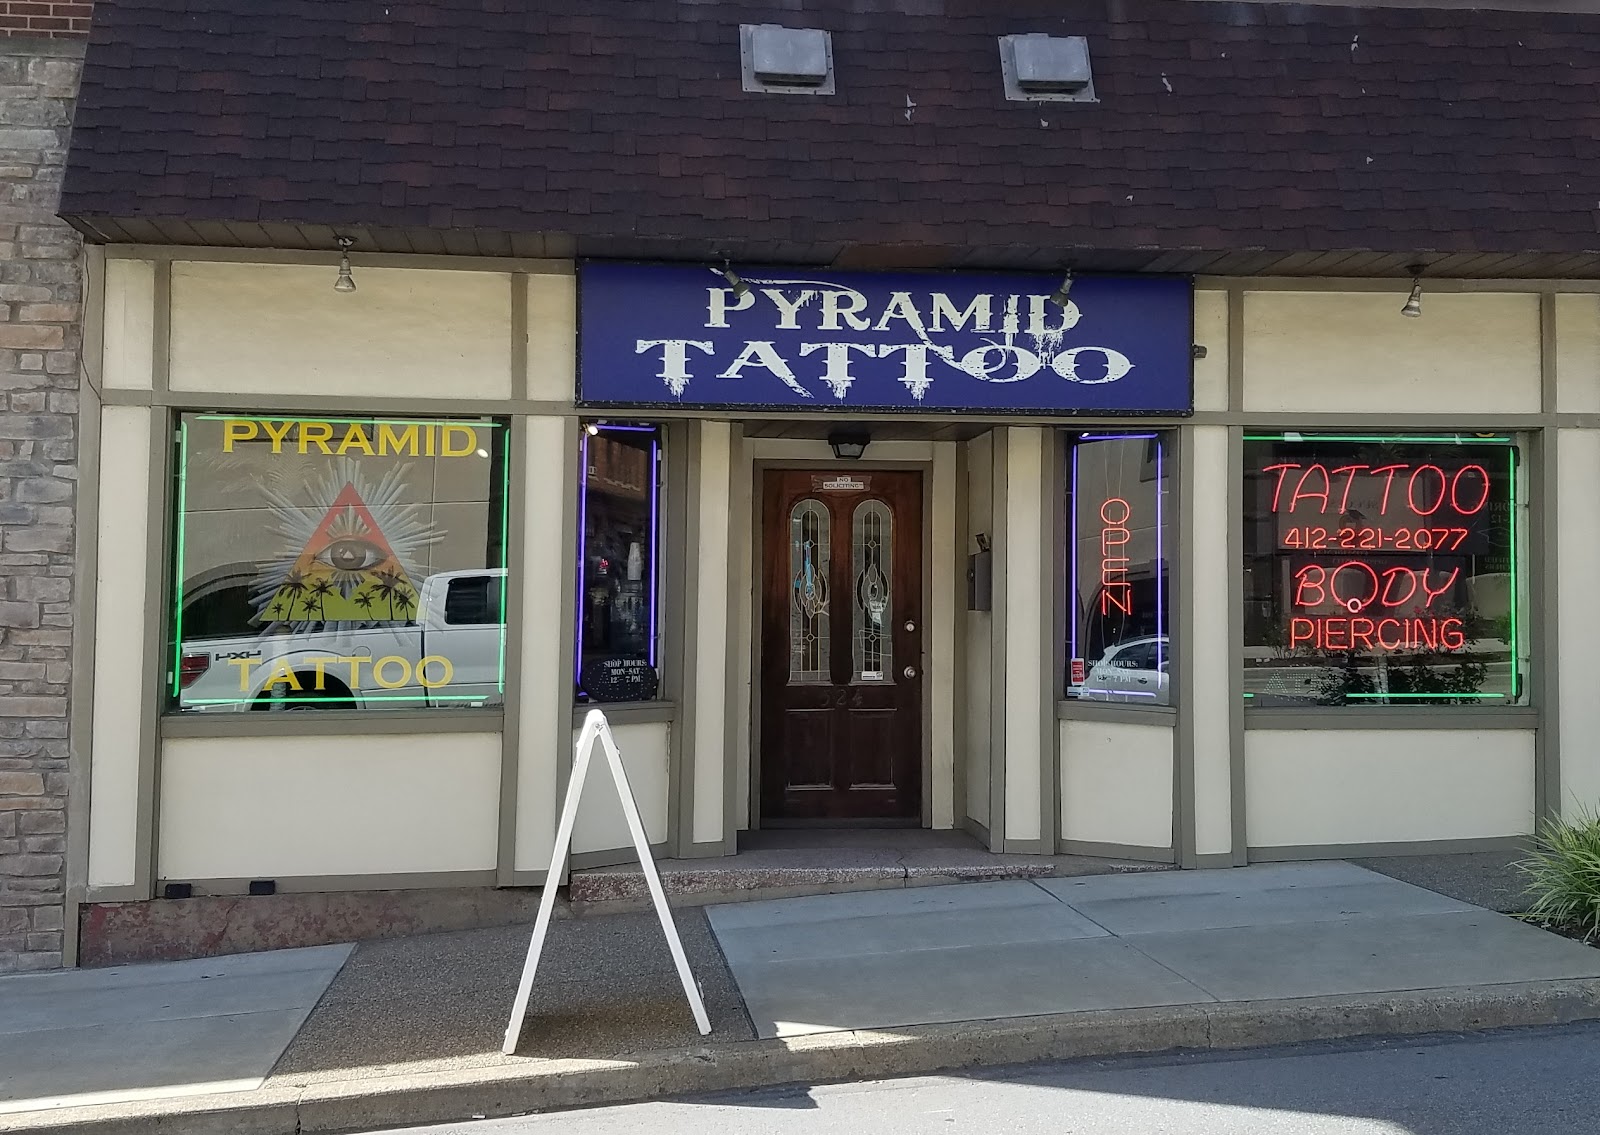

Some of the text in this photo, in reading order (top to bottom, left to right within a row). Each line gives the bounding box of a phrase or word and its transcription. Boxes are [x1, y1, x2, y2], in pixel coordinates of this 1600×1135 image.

[703, 281, 1083, 337] PYRAMID
[635, 338, 1136, 400] TATTOO
[222, 418, 478, 458] PYRAMID
[1262, 463, 1491, 516] TATTOO
[1100, 498, 1132, 616] OPEN
[1284, 527, 1468, 551] 412-221-2077
[1295, 561, 1460, 613] BODY
[1290, 617, 1465, 650] PIERCING
[227, 654, 455, 692] TATTOO
[604, 659, 622, 668] SHOP
